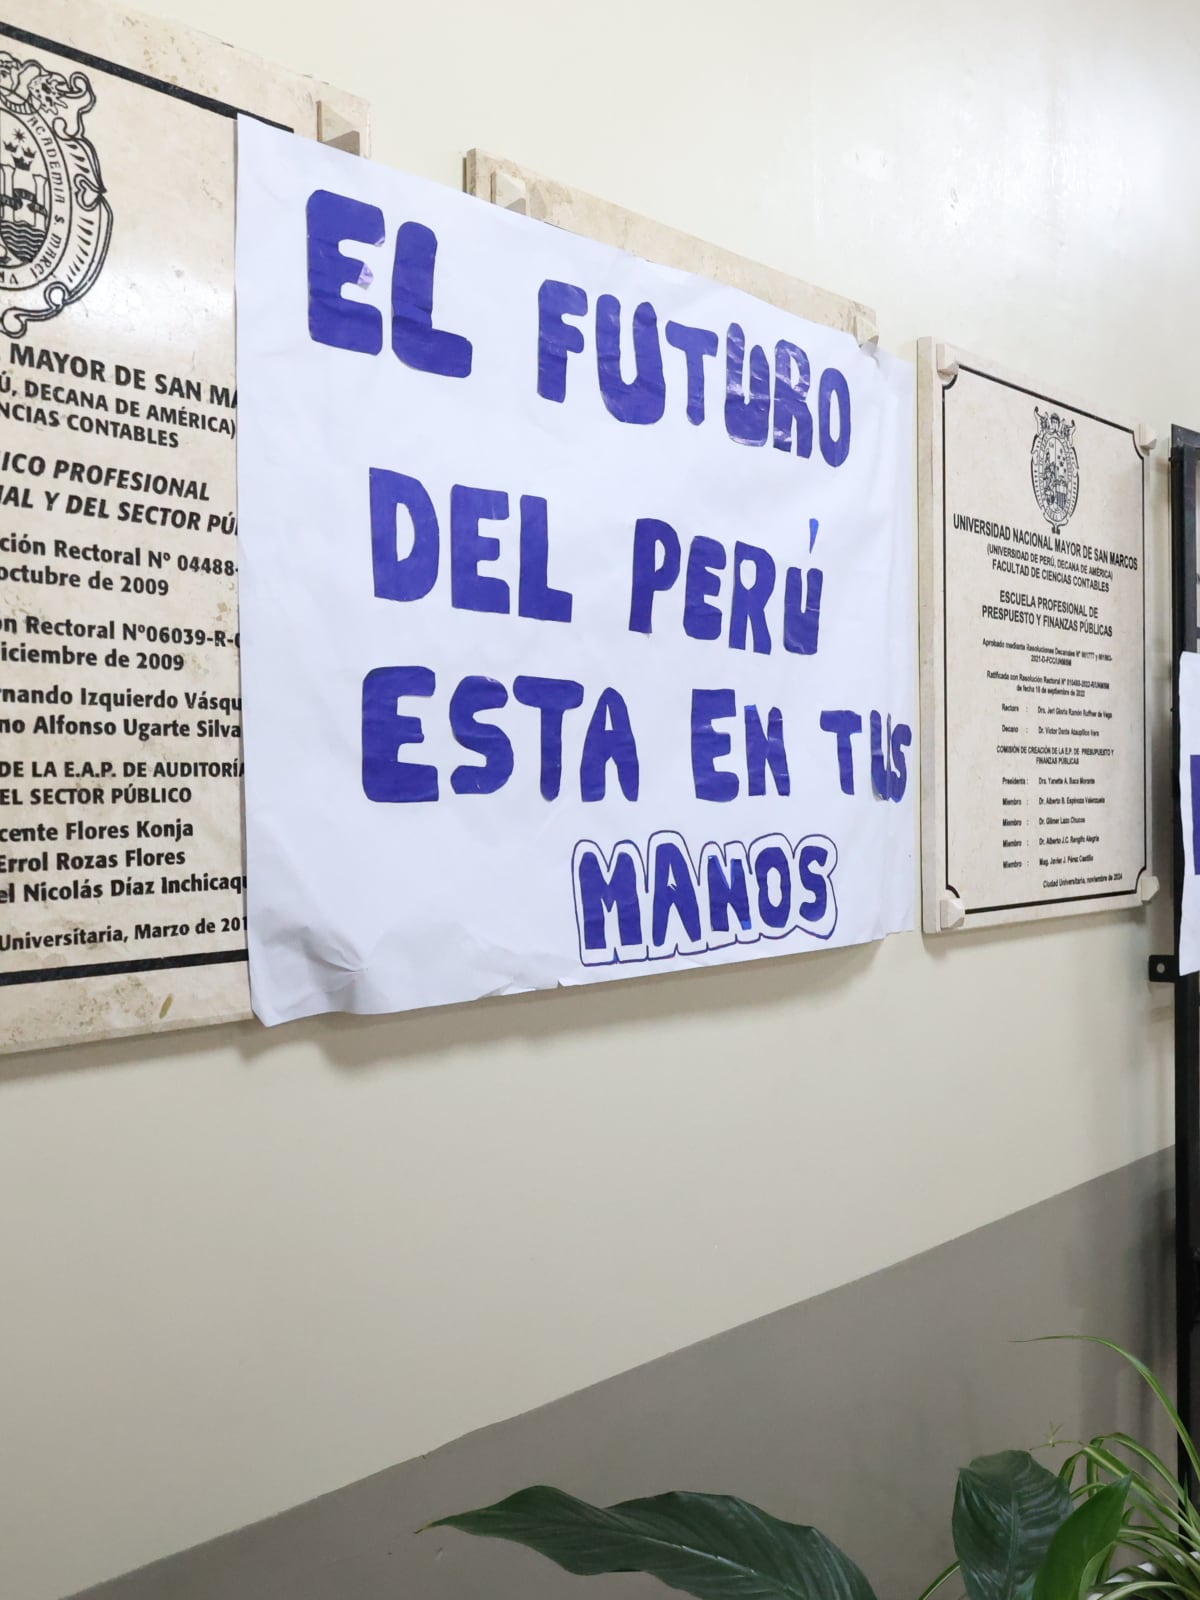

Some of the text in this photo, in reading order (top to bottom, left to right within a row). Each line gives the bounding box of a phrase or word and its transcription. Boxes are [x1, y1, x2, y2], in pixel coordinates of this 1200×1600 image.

[305, 189, 851, 468] EL FUTURO
[10, 343, 106, 382] MAYOR
[115, 365, 146, 390] DE
[155, 374, 201, 401] SAN
[25, 380, 108, 411] DECANA
[115, 398, 139, 417] DE
[146, 406, 236, 439] AMÉRICA)
[67, 414, 178, 448] CONTABLES
[53, 460, 209, 501] PROFESIONAL
[45, 490, 60, 511] Y
[65, 495, 110, 519] DEL
[117, 502, 200, 530] SECTOR
[54, 540, 141, 566] Rectoral
[953, 512, 1138, 571] UNIVERSIDAD NACIONAL MAYOR DE SAN MARCOS
[369, 467, 823, 656] DEL PERÚ
[987, 543, 1029, 562] (UNIVERSIDAD
[1057, 559, 1079, 573] DECANA
[1080, 564, 1088, 574] DE
[0, 565, 169, 596] octubre de 2009
[992, 558, 1109, 593] FACULTAD DE CIENCIAS CONTABLES
[1000, 590, 1098, 618] ESCUELA PROFESIONAL DE
[26, 615, 114, 640] Rectoral
[982, 605, 1112, 637] PRESPUESTO Y FINANZAS PÚBLICAS
[105, 650, 130, 668] de
[137, 653, 184, 671] 2009
[81, 688, 178, 712] Izquierdo
[33, 715, 116, 736] Alfonso
[123, 719, 190, 741] Ugarte
[197, 719, 241, 738] Silva
[362, 665, 912, 803] ESTA EN TUS
[0, 761, 23, 777] DE
[32, 761, 57, 777] LA
[65, 761, 116, 778] E.A.P.
[123, 762, 147, 777] DE
[30, 788, 104, 805] SECTOR
[112, 784, 192, 804] PÚBLICO
[66, 821, 130, 841] Flores
[137, 819, 193, 843] Konja
[0, 849, 186, 873] Errol Rozas Flores
[24, 881, 103, 903] Nicolás
[111, 876, 154, 898] Díaz
[576, 838, 833, 954] MANOS
[0, 923, 128, 952] Universitaria,
[135, 923, 190, 940] Marzo
[195, 917, 216, 935] de
